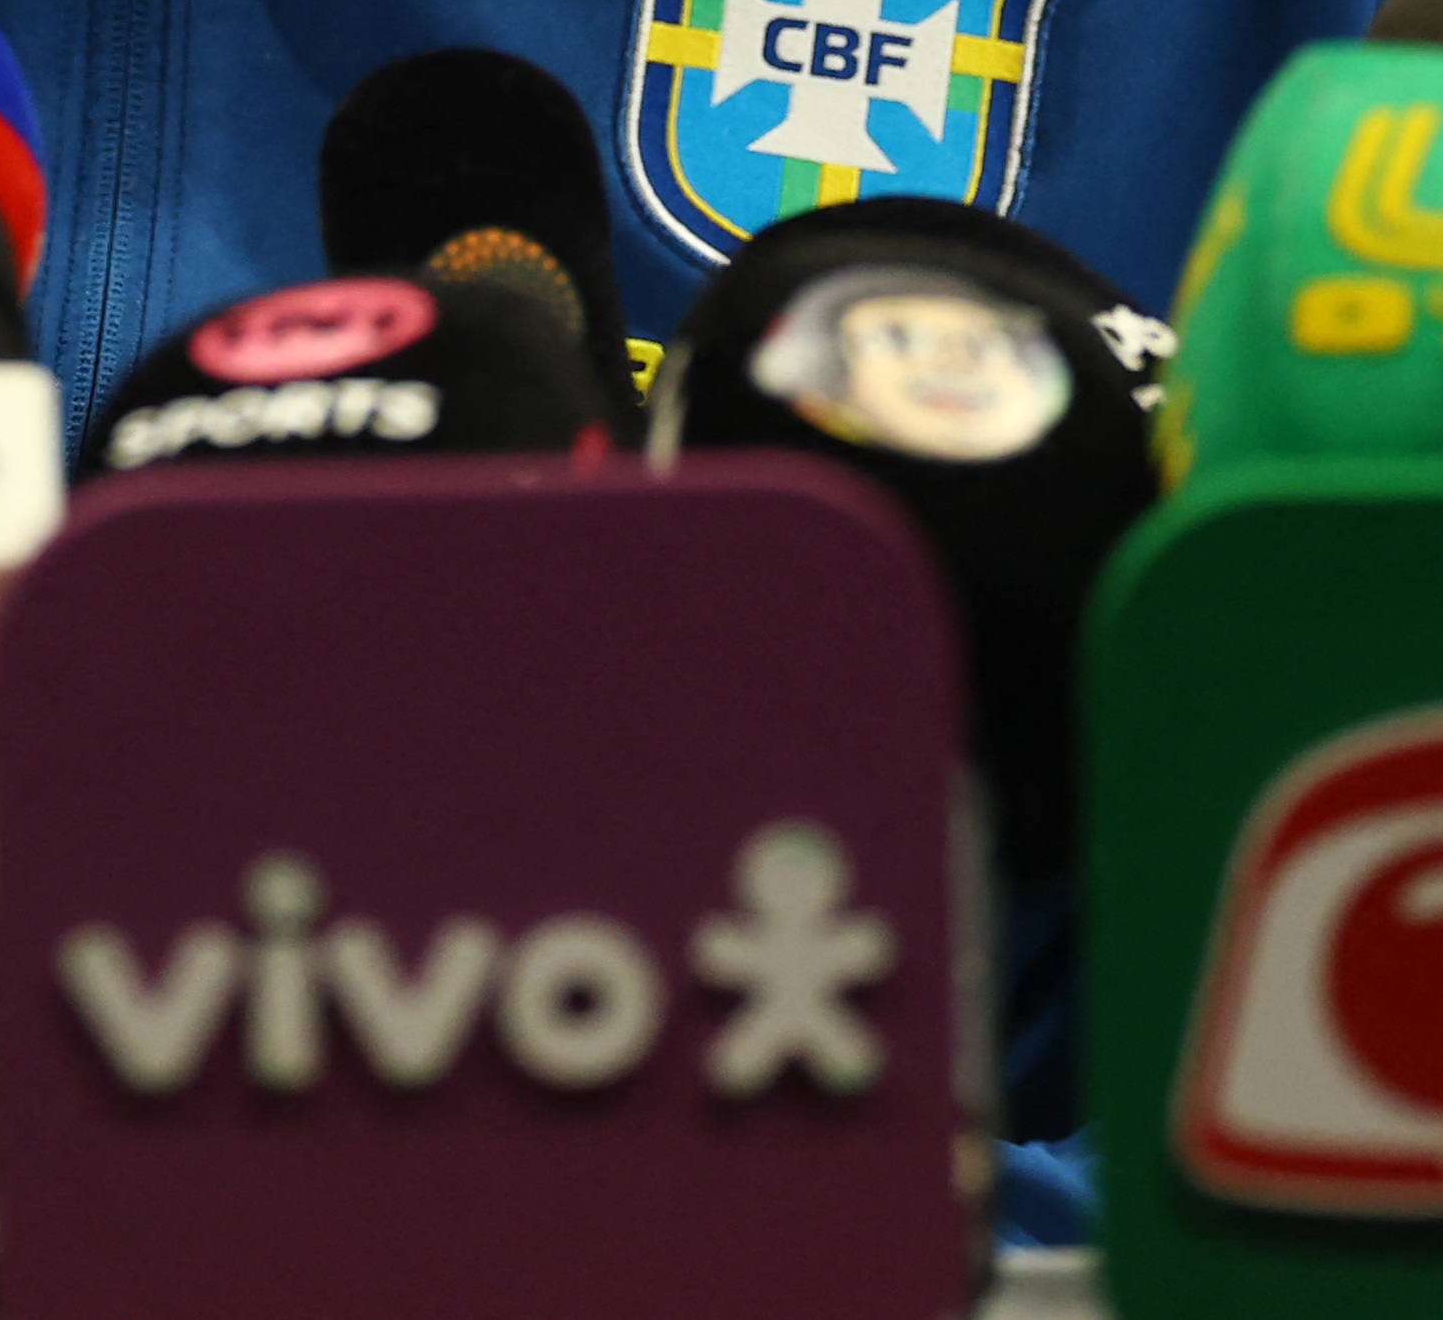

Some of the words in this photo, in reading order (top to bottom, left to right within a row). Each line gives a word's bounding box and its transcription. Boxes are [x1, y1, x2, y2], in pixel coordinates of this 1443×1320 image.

[761, 17, 913, 87] CBF
[110, 377, 440, 470] SPORTS
[62, 850, 663, 1091] vivo
